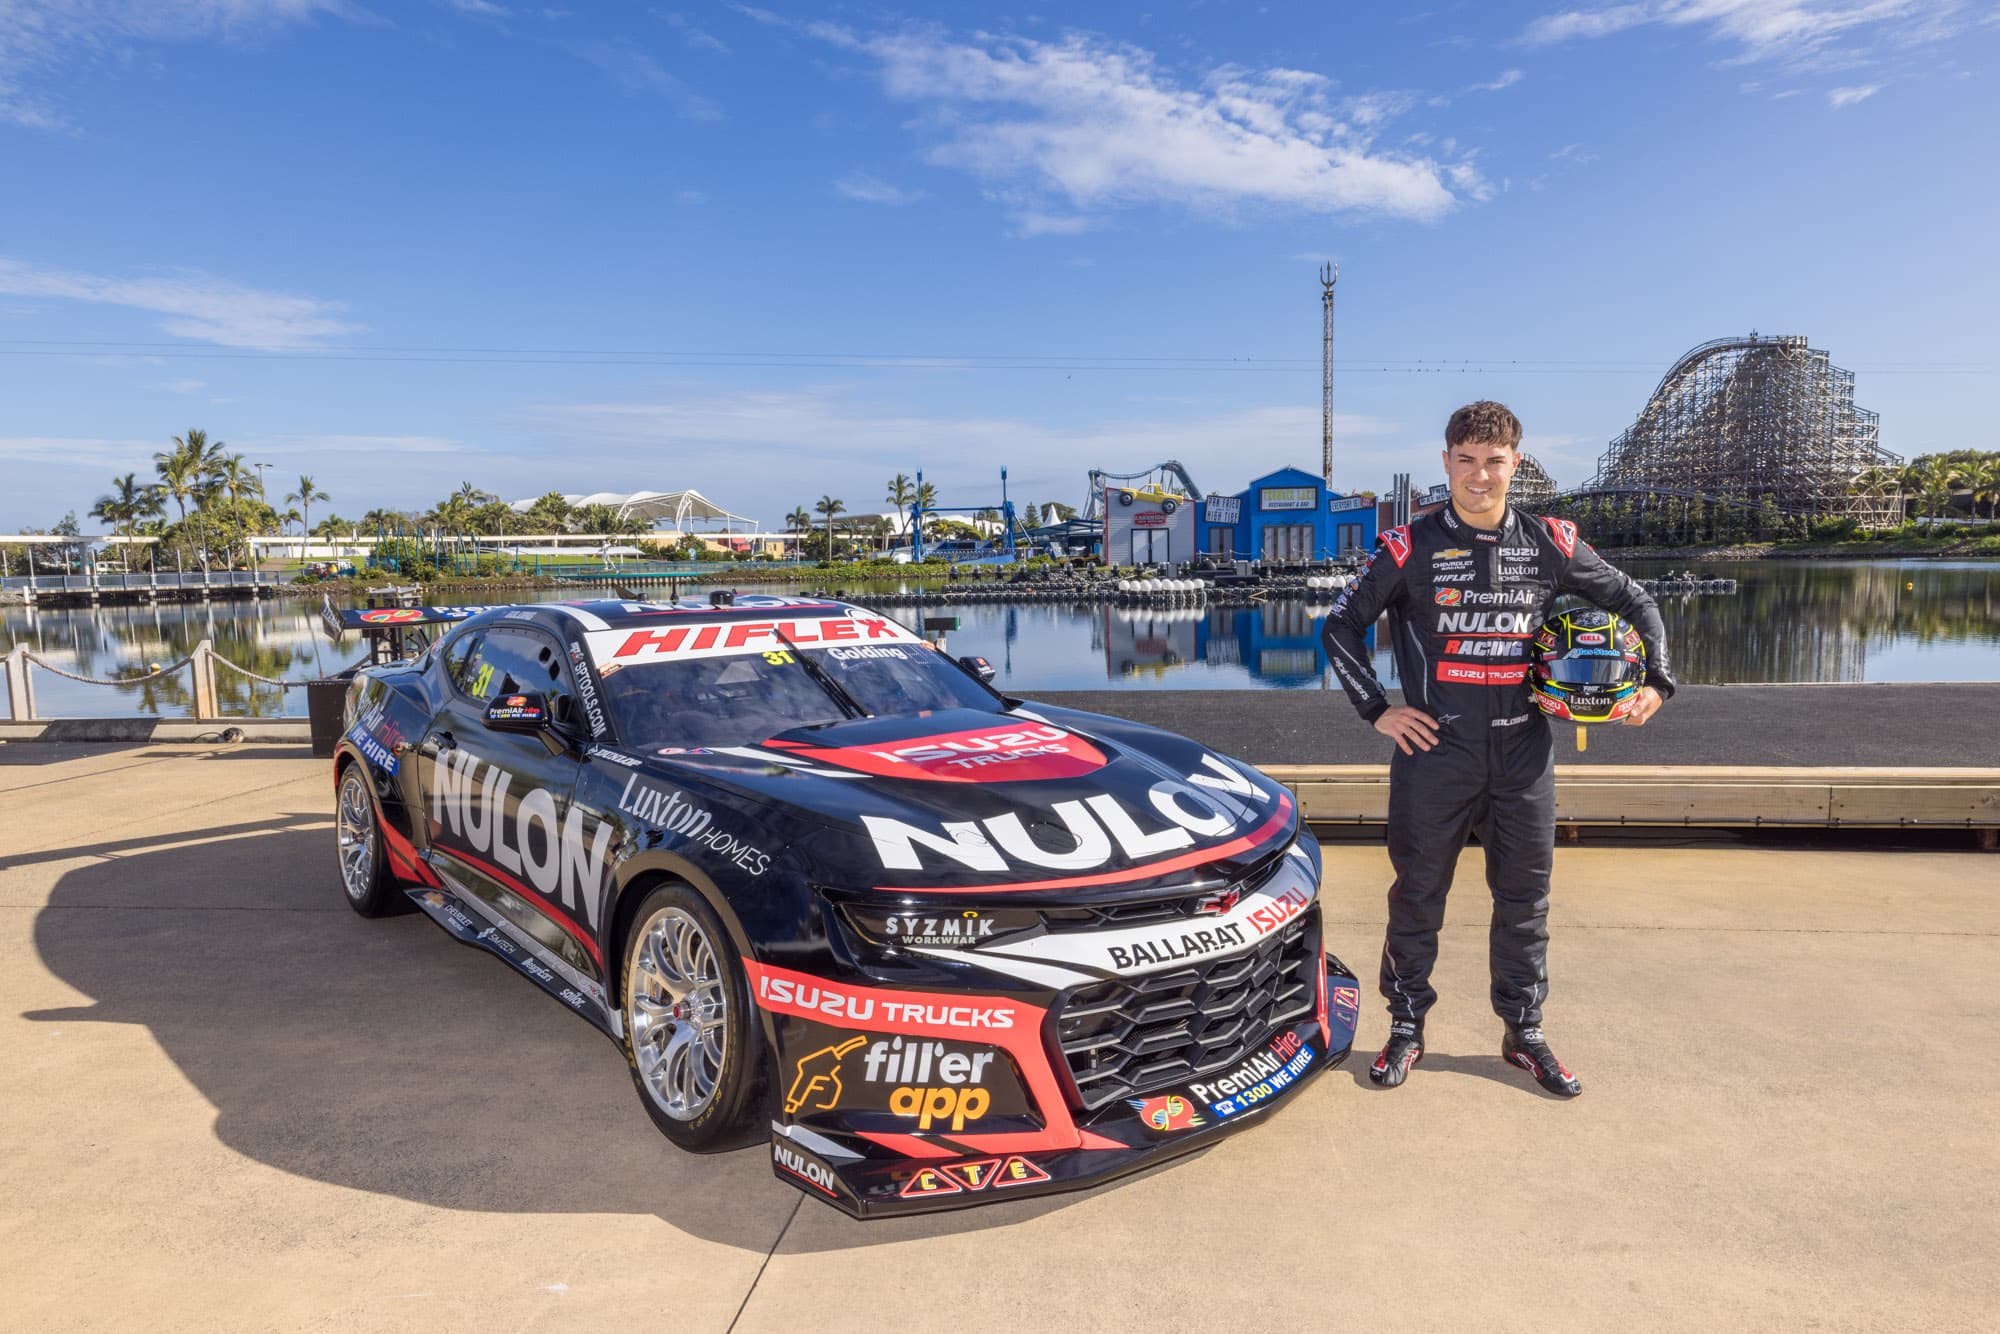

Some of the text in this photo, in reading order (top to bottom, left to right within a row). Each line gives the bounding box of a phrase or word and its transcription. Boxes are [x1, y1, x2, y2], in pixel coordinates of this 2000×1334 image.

[1432, 560, 1474, 569] CHEVROLET
[1498, 547, 1539, 557] ISUZU
[1498, 564, 1539, 576] Luxton
[1462, 589, 1535, 605] PremiAir
[614, 618, 899, 658] HIFLEX
[1437, 612, 1532, 633] NULON
[762, 650, 795, 666] 31
[827, 647, 908, 661] Golding
[1443, 639, 1523, 657] RACING
[472, 663, 495, 698] 31
[1447, 669, 1524, 679] ISUZU TRUCKS
[575, 661, 607, 738] SPTOOLS.COM
[1570, 695, 1611, 705] Luxton
[362, 738, 397, 772] HIRE
[870, 727, 1069, 763] ISUZU
[947, 743, 1069, 769] TRUCKS
[619, 773, 770, 875] Luxton HOMES
[860, 754, 1270, 872] NULON
[433, 747, 614, 932] NULON
[885, 911, 995, 936] SYZMIK
[901, 935, 976, 945] WORKWEAR
[1107, 886, 1308, 970] BALLARAT ISUZU
[760, 975, 1015, 1028] ISUZU TRUCKS
[1189, 1029, 1303, 1106] PremiAir Hire
[1234, 1047, 1314, 1108] 1300 WE HIRE
[889, 1087, 990, 1131] app
[774, 1144, 834, 1192] NULON
